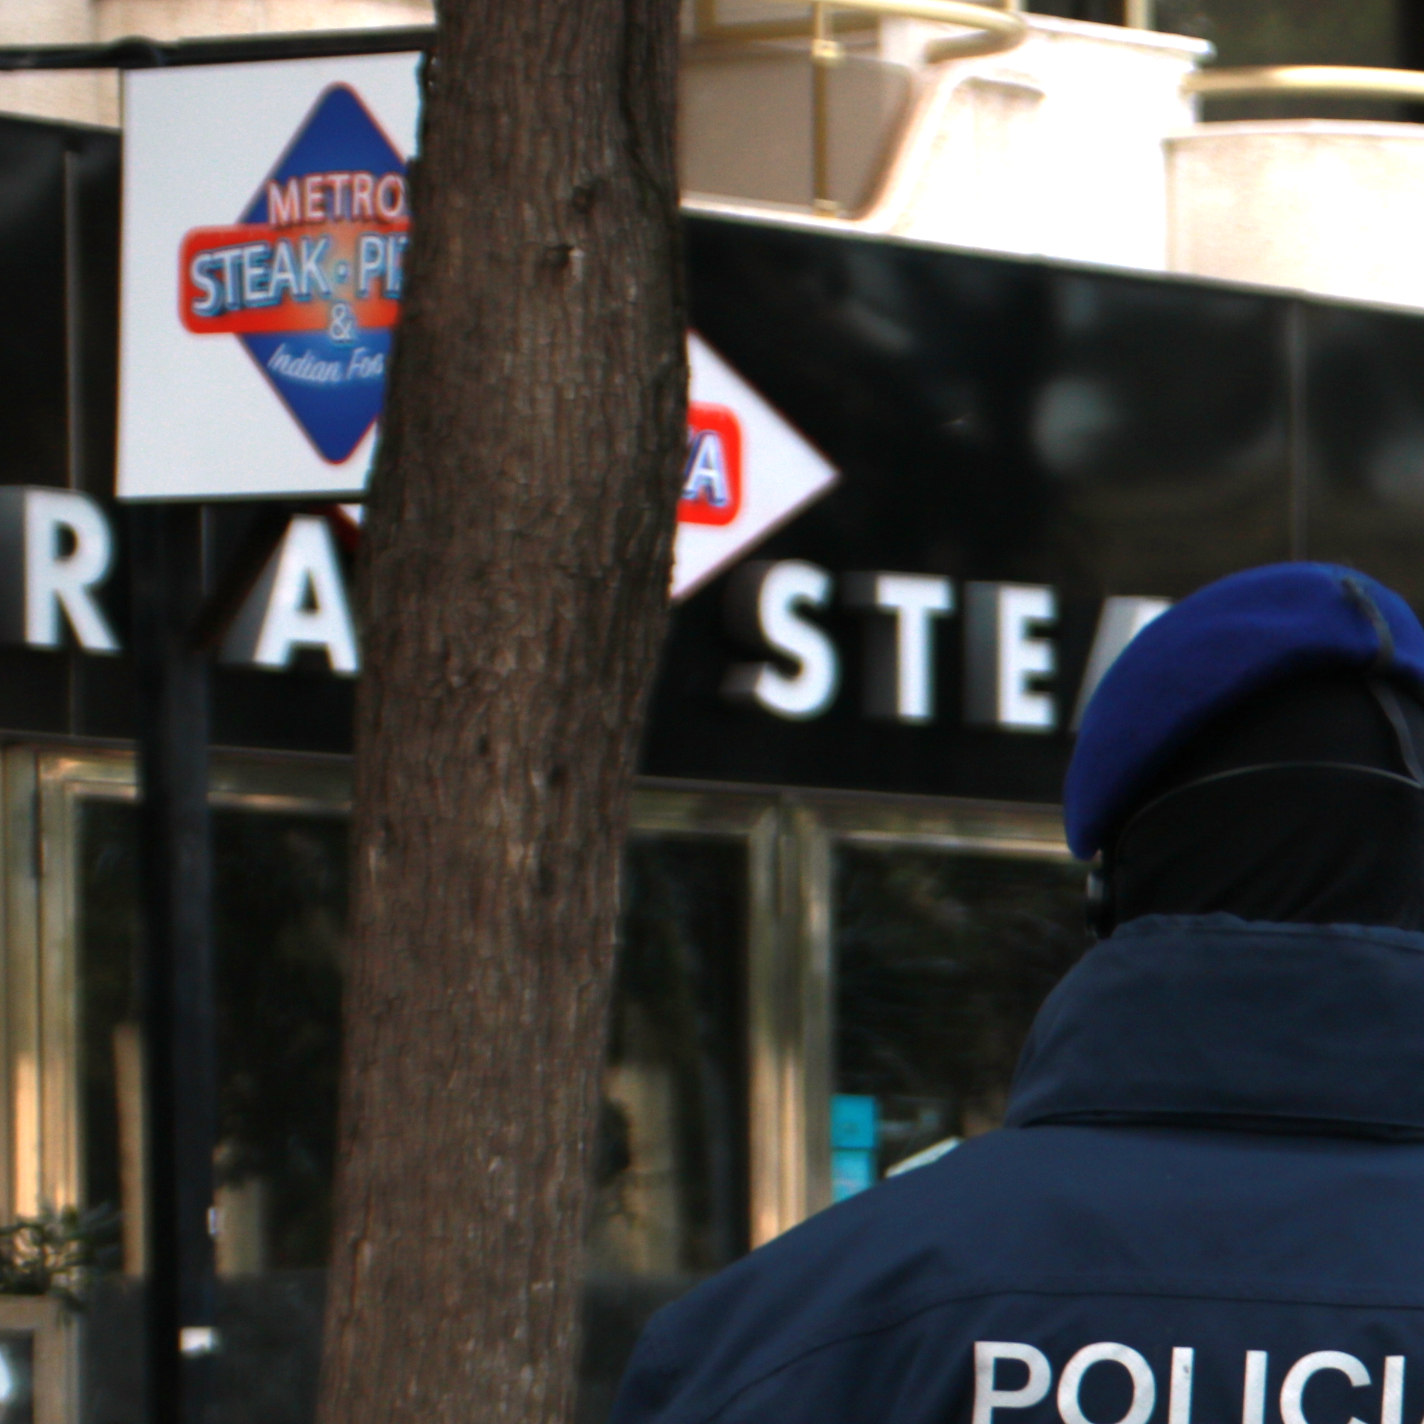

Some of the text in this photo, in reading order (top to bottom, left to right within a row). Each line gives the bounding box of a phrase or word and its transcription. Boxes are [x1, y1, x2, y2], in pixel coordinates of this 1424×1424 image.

[191, 233, 408, 316] STEAK PI
[328, 301, 357, 343] &
[267, 343, 342, 383] Indian
[745, 558, 1175, 735] STE
